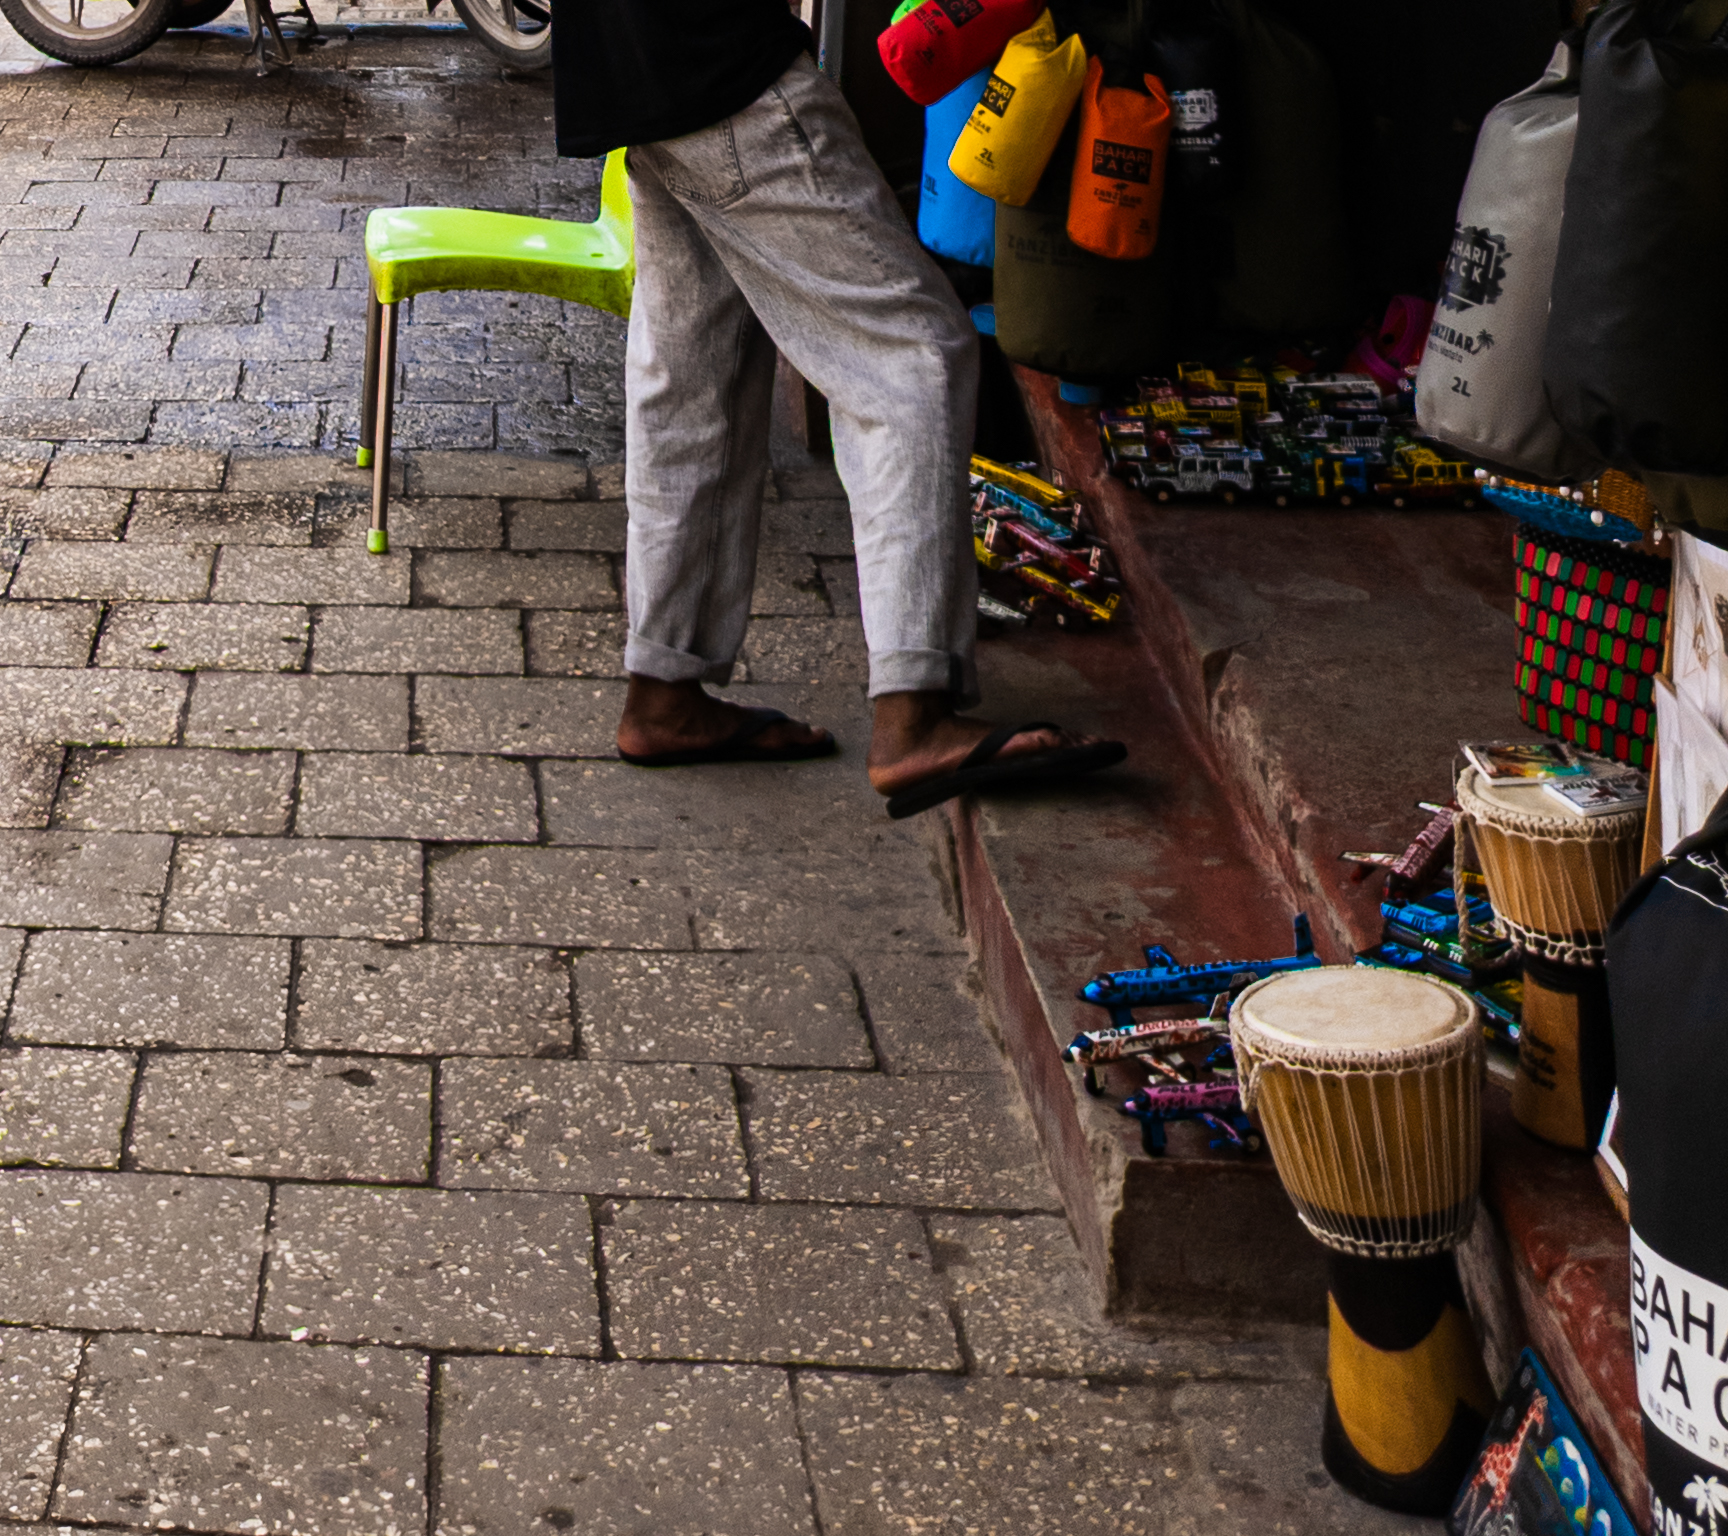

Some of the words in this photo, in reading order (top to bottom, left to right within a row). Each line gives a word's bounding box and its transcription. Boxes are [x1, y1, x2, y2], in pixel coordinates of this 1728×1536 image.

[1094, 142, 1151, 164] BAHARI
[1450, 238, 1489, 267] AHARI
[1446, 254, 1484, 284] ACK
[1451, 376, 1472, 398] 2L
[1632, 1248, 1728, 1365] BAH
[1633, 1313, 1728, 1432] PAC
